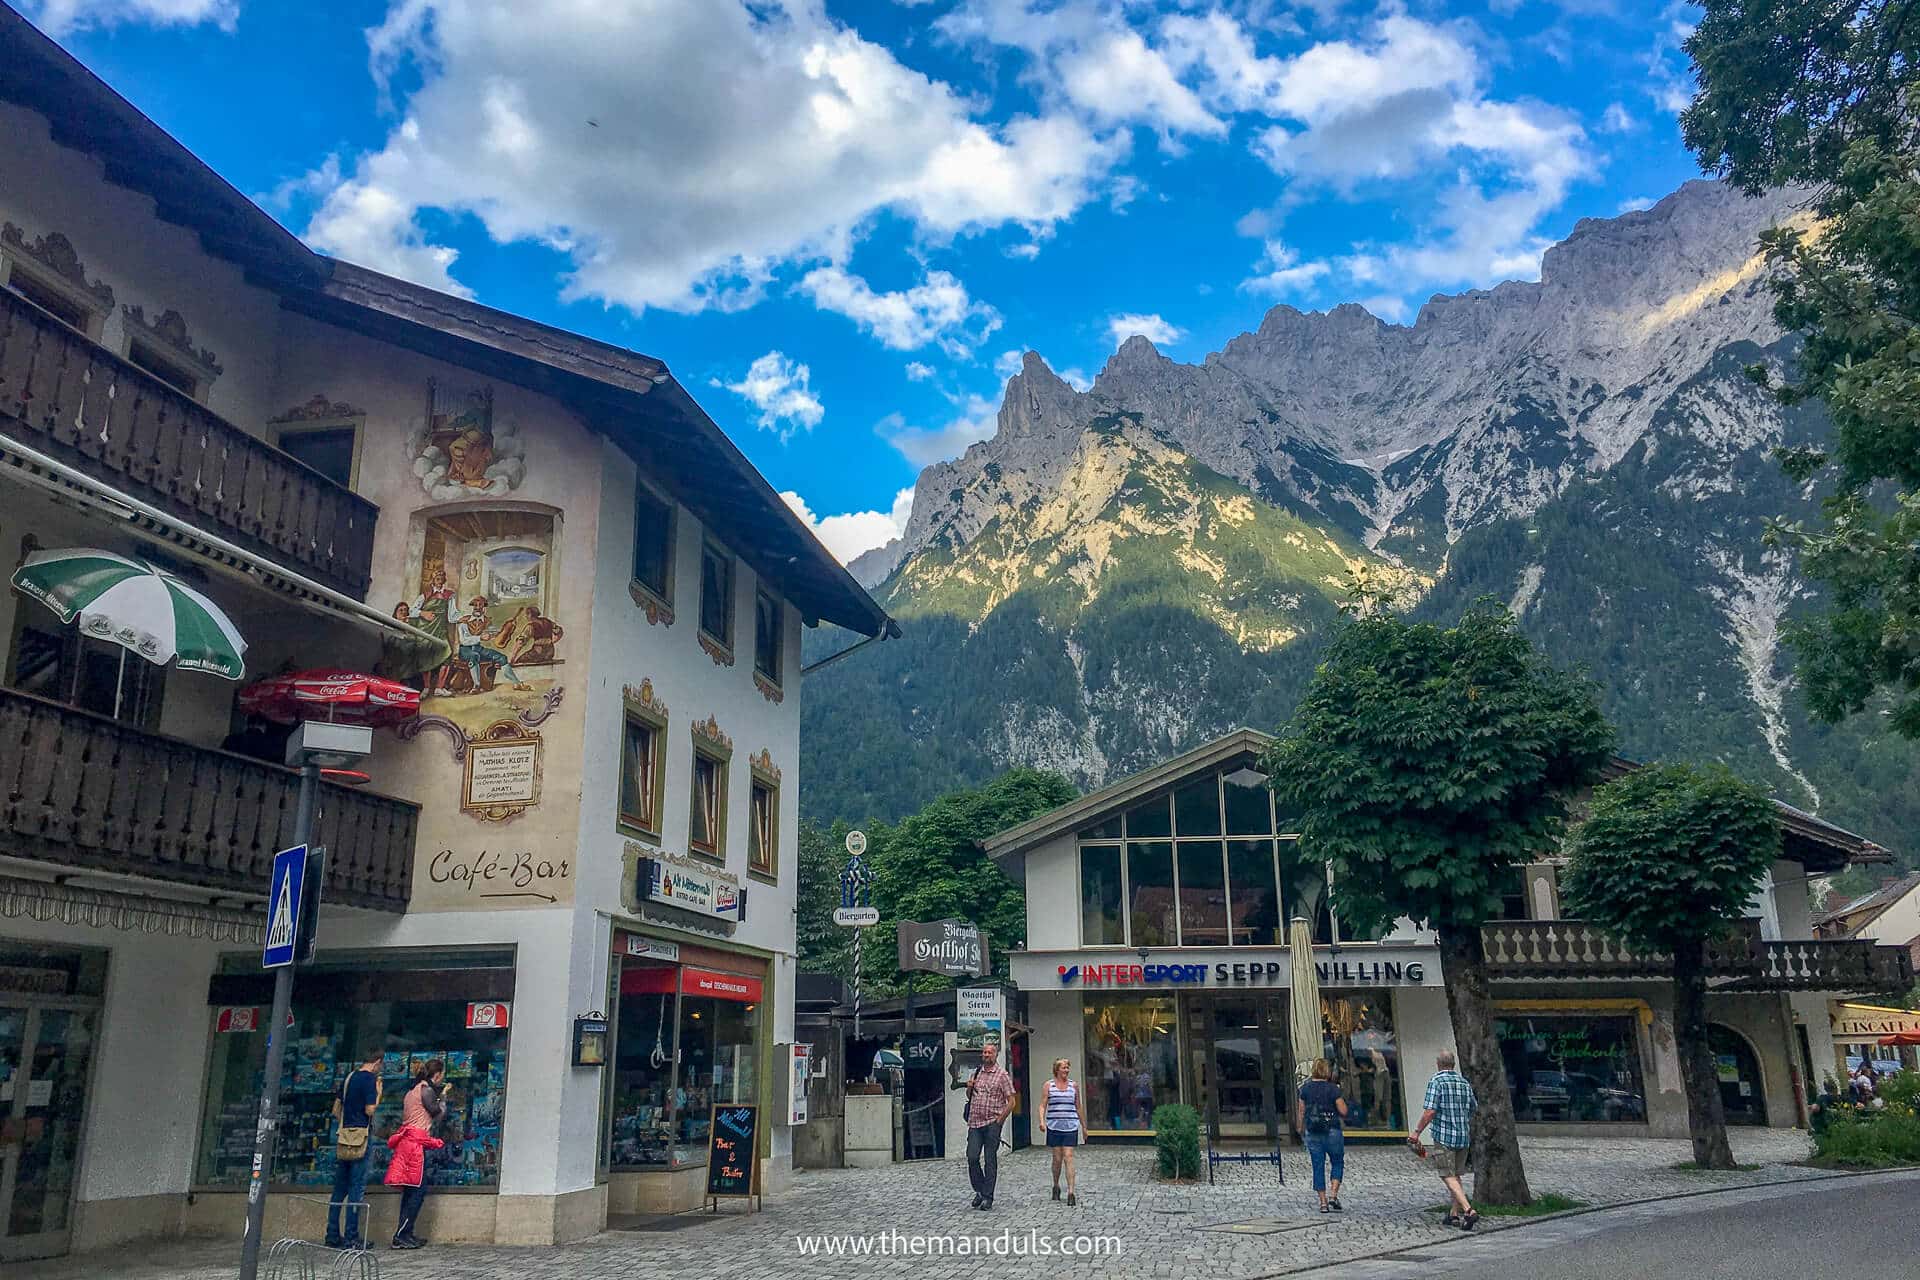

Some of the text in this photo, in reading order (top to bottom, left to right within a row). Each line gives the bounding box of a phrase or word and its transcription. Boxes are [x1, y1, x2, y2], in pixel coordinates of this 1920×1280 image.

[320, 686, 348, 695] Coca-Cola
[387, 692, 406, 701] Coca-Cola
[429, 850, 569, 890] Café-Bar
[839, 911, 876, 921] Biergarten
[914, 938, 969, 963] Gasthof
[1082, 961, 1424, 985] INTERSPORT SEPP NILLING
[962, 991, 995, 1000] Gasthof
[968, 1001, 990, 1010] Stern
[909, 1042, 938, 1061] sky
[716, 1137, 735, 1149] Bar
